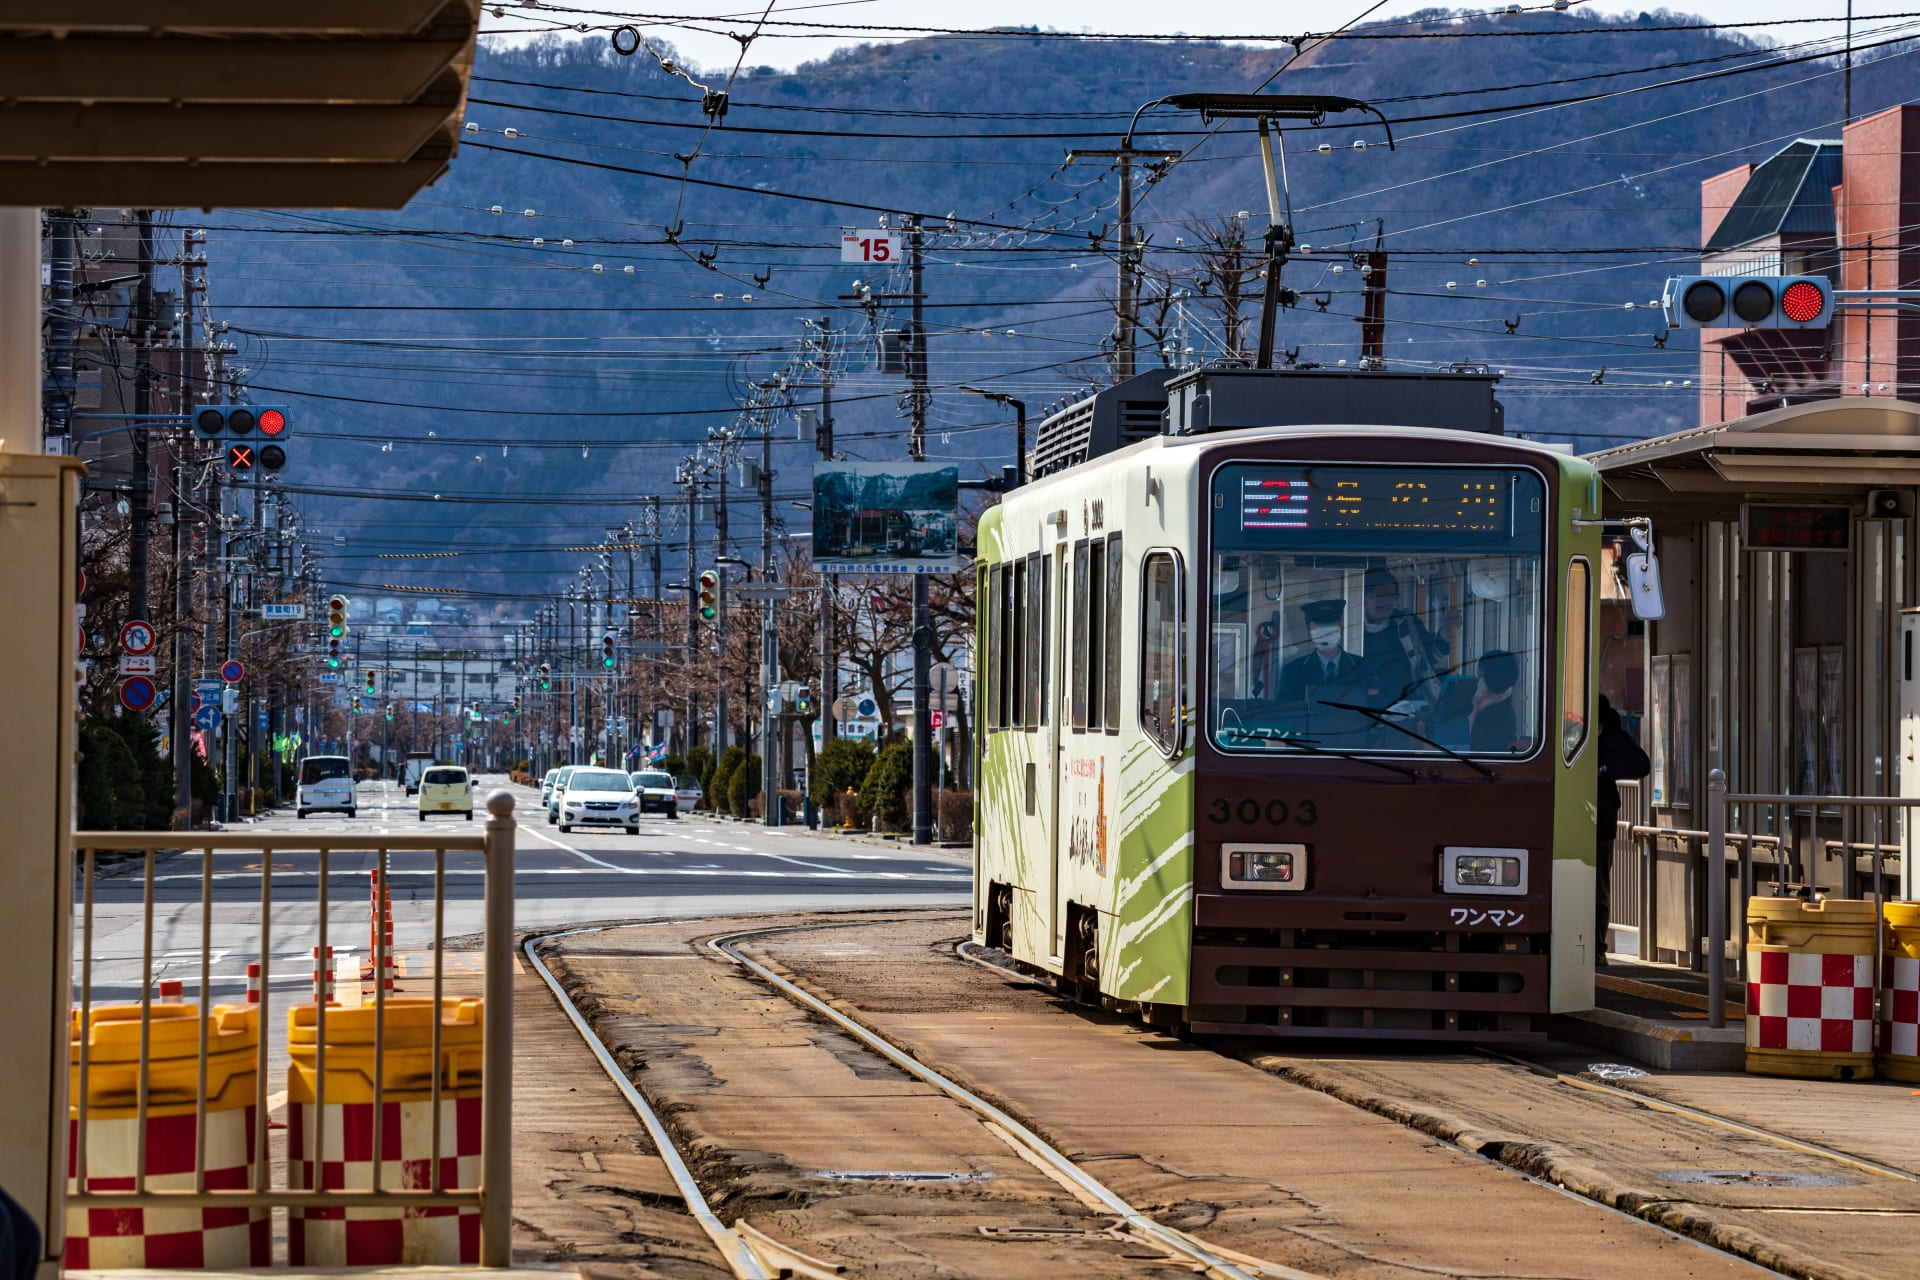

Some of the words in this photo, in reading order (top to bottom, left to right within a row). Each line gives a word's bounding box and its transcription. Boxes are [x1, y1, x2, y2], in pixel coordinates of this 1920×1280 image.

[859, 238, 889, 262] 15
[1208, 798, 1319, 826] 3003
[1450, 908, 1524, 927] ワンマン
